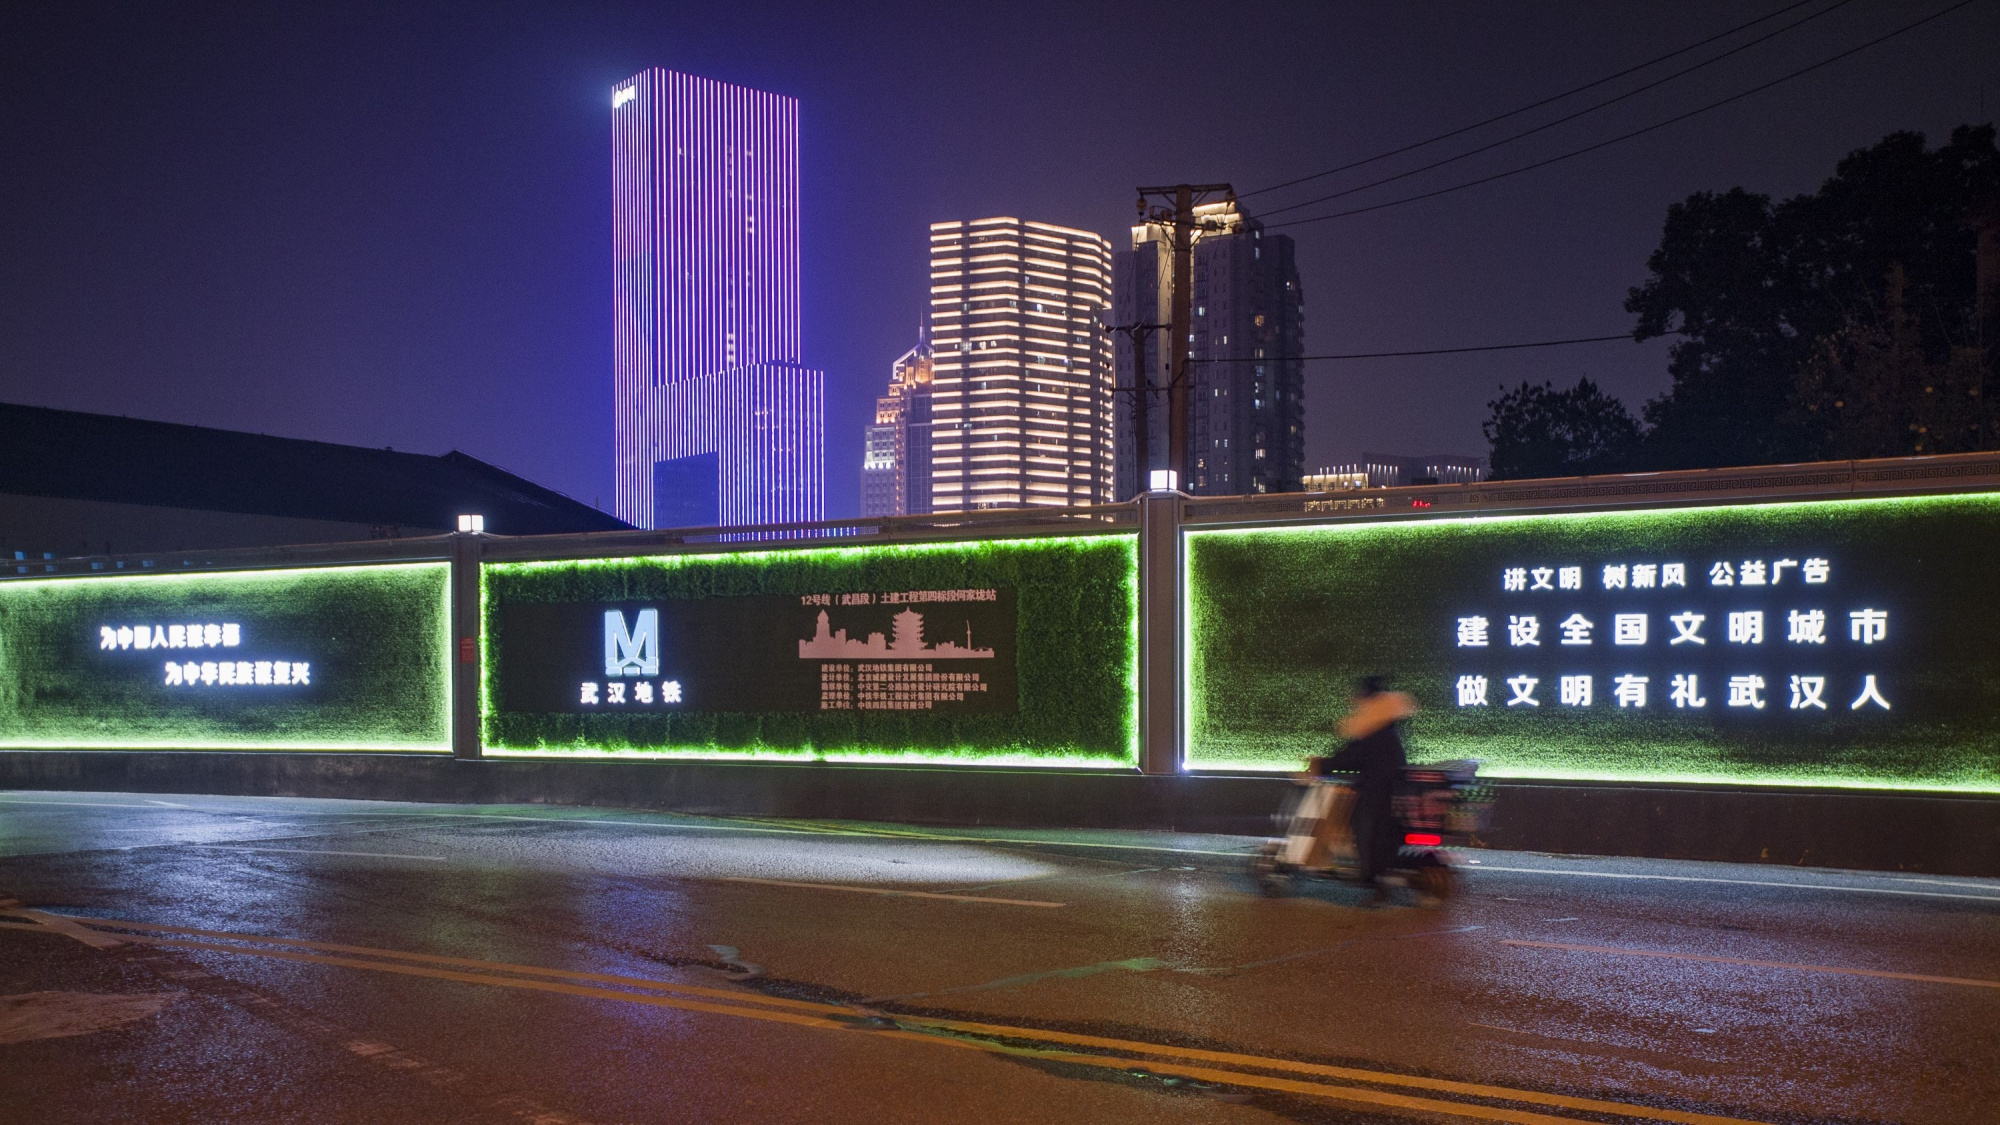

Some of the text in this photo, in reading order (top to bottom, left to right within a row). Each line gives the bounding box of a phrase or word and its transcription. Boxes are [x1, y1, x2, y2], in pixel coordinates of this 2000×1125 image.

[1503, 557, 1830, 592] 讲文明 树新风 公益广告
[1457, 608, 1888, 647] 建设全国文明城市
[580, 680, 682, 705] 武汉地铁
[1455, 673, 1890, 710] 做文明有礼武汉人
